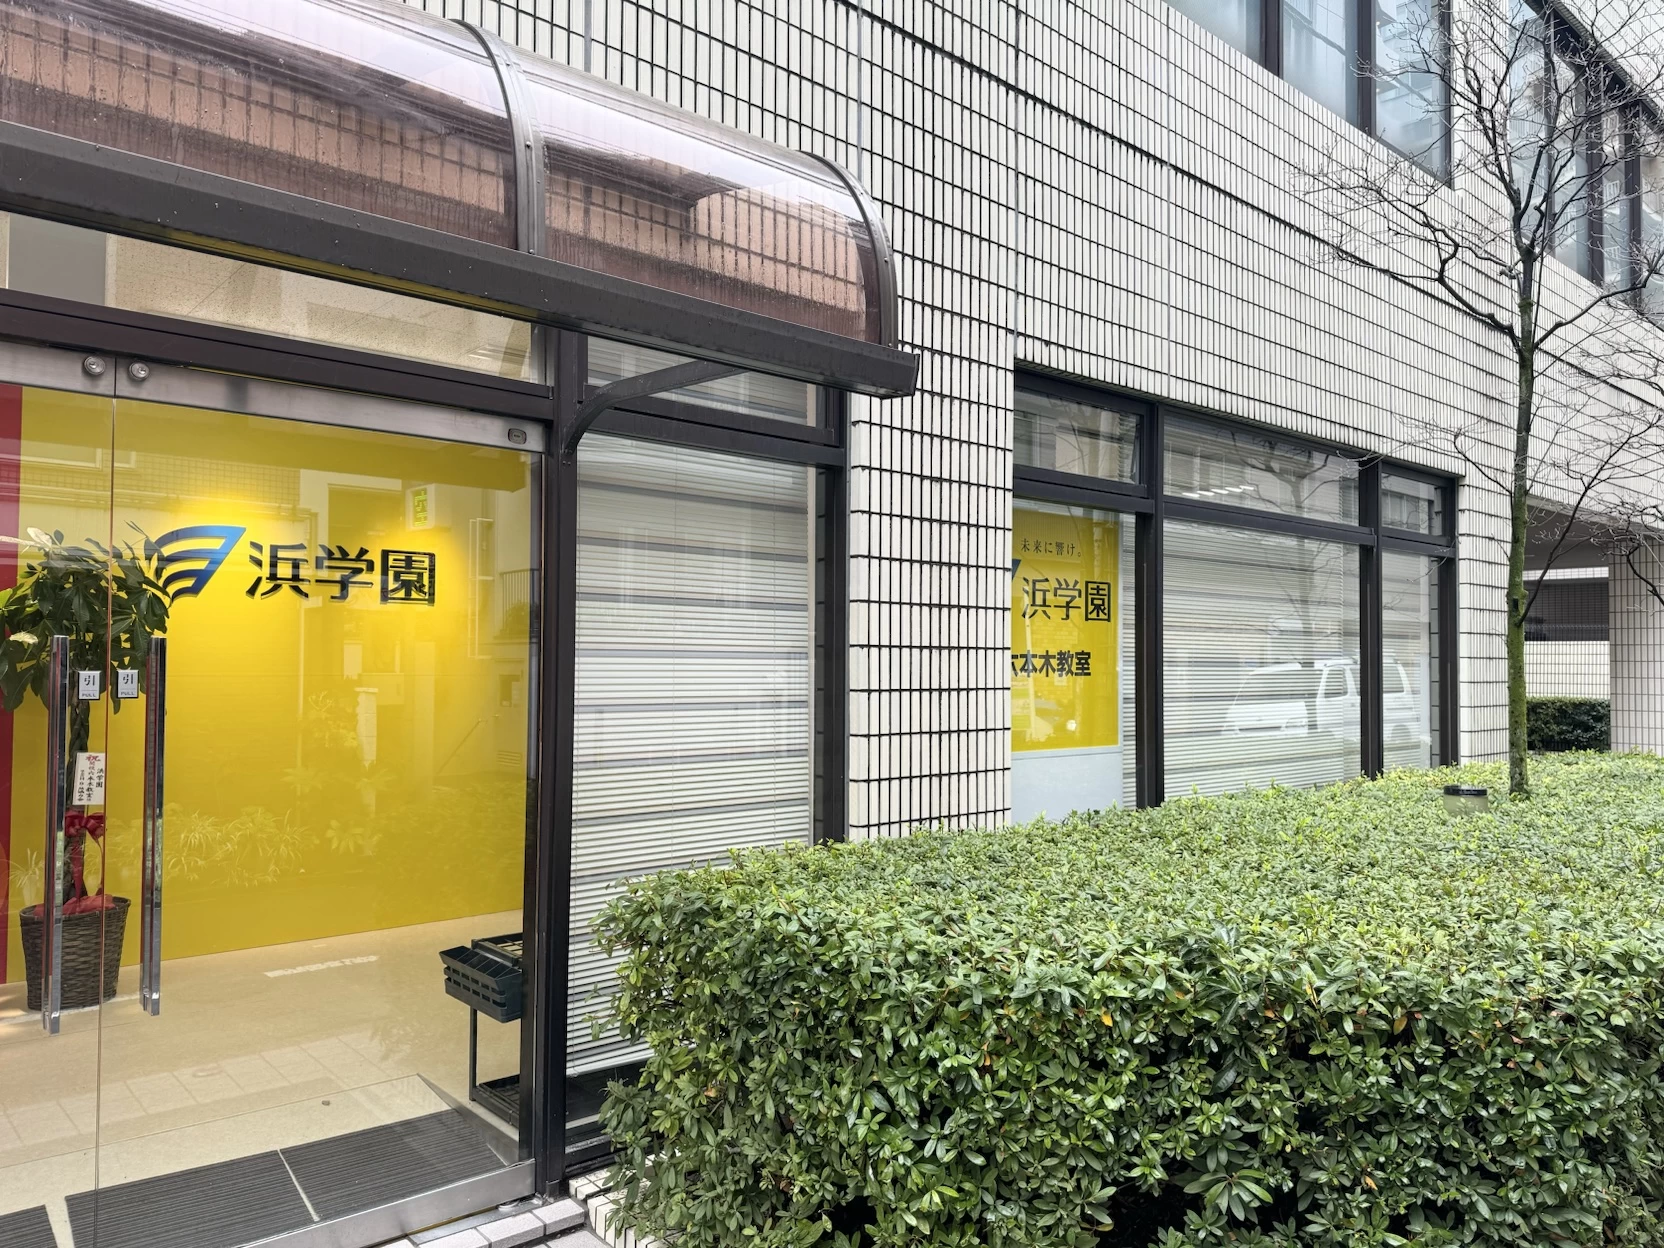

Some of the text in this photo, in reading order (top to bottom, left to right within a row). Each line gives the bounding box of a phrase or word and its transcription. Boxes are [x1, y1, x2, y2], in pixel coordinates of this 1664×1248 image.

[1020, 538, 1082, 557] 未来に響け。
[246, 541, 436, 606] 浜学園
[1021, 577, 1111, 622] 浜学園
[84, 674, 96, 686] 引
[122, 673, 134, 685] 引
